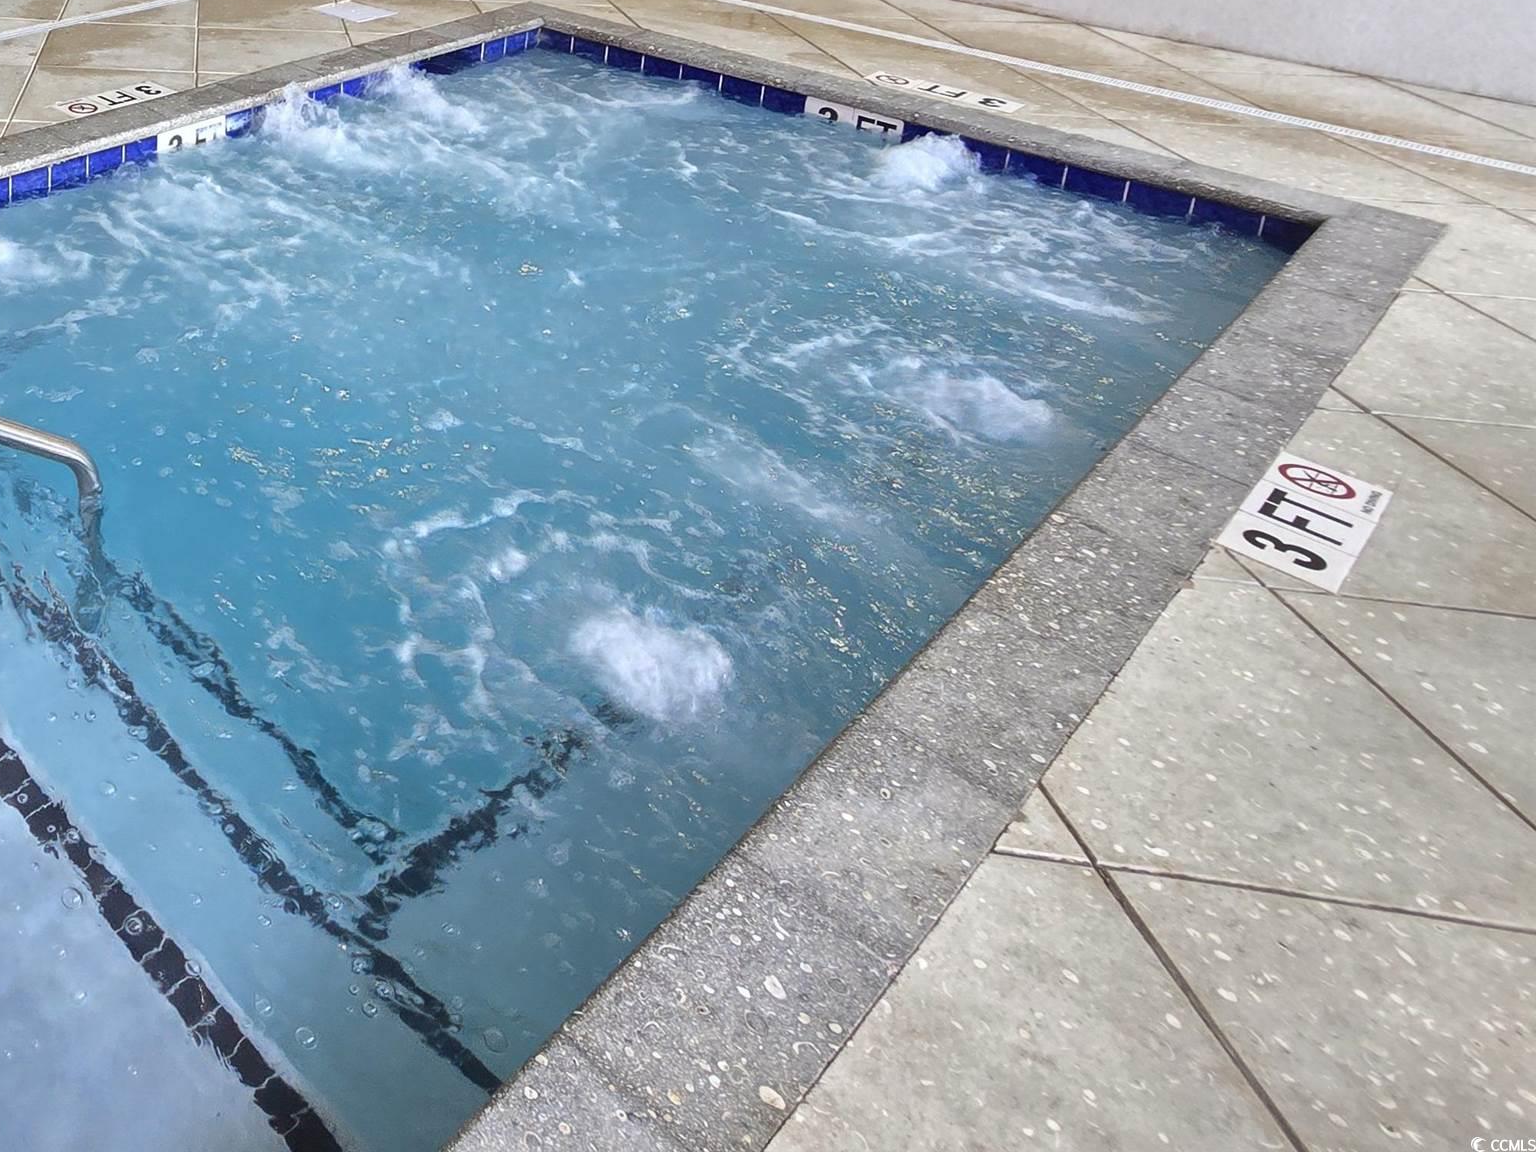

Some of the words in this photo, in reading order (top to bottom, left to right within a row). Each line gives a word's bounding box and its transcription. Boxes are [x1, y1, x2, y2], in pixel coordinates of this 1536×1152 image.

[97, 90, 137, 106] FT
[135, 86, 162, 96] 3
[918, 84, 966, 98] FT
[978, 97, 1008, 108] 3
[1258, 488, 1354, 547] FT
[1242, 530, 1328, 571] 3
